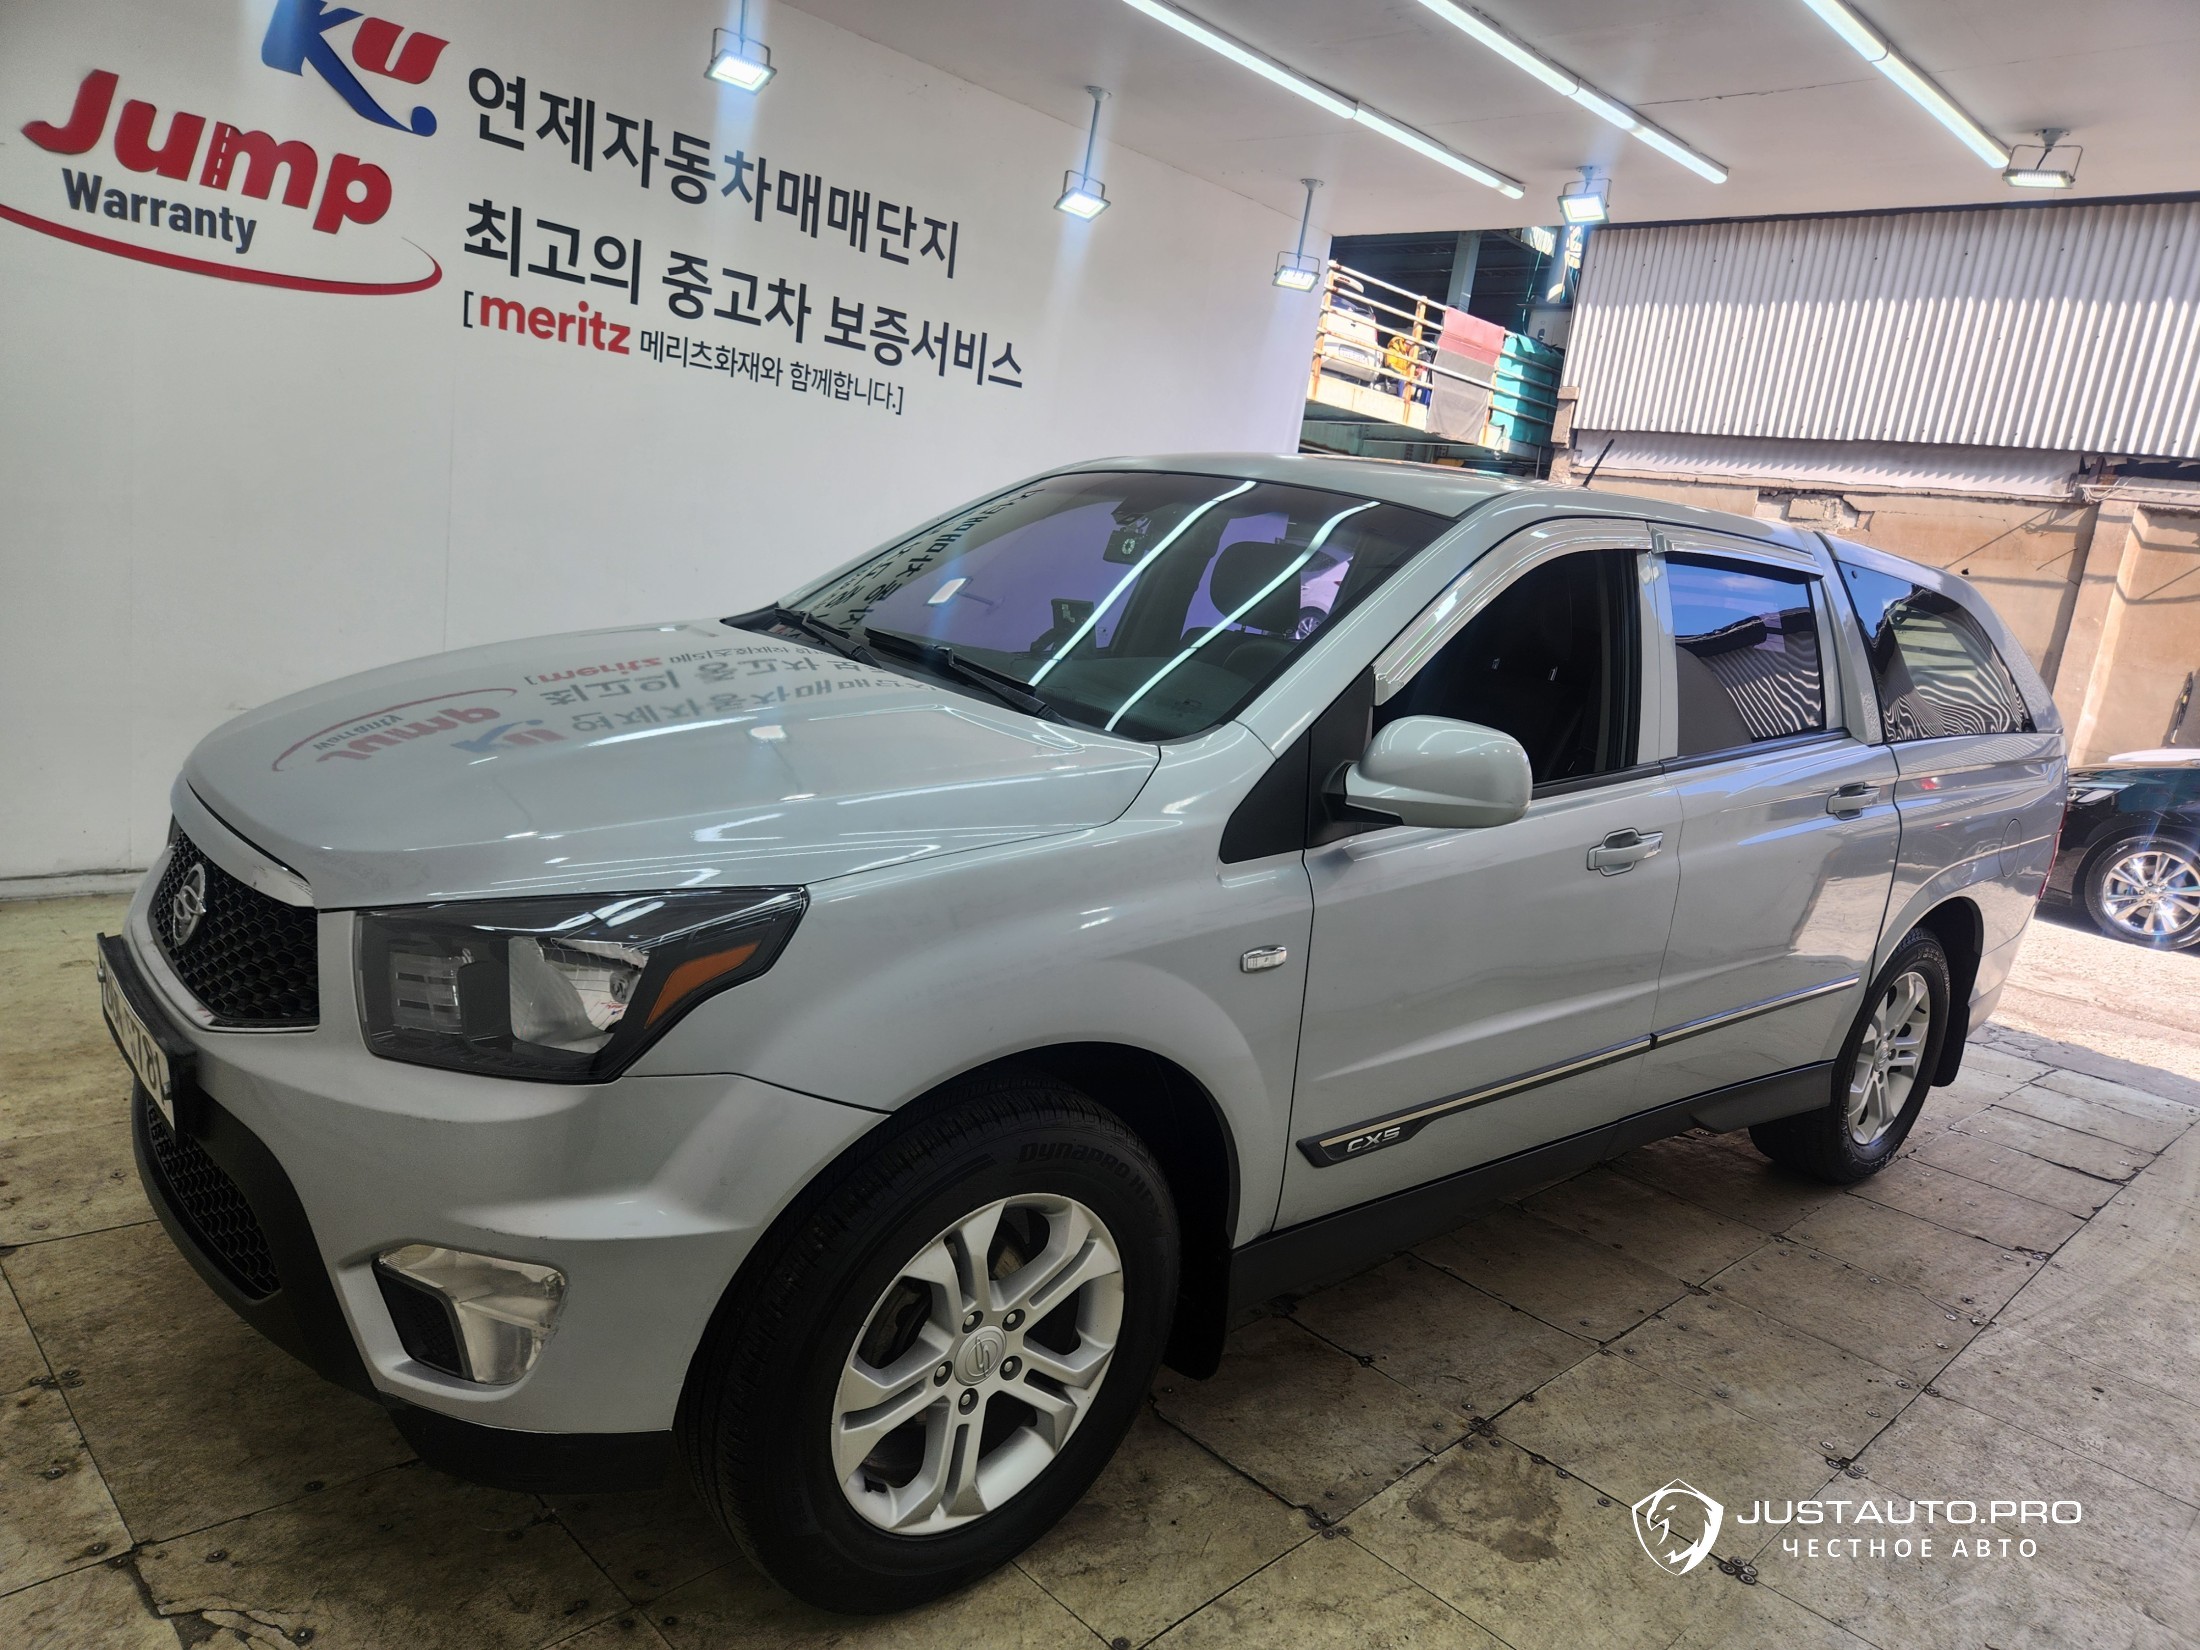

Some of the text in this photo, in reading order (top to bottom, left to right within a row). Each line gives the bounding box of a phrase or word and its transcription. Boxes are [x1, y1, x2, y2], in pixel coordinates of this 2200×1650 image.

[21, 68, 392, 235] Jump
[61, 167, 257, 254] Warranty
[467, 66, 960, 279] 연제자동차매매단지
[463, 199, 1023, 388] 최고의 중고차 보증서비스
[640, 329, 784, 388] 메리츠화재와
[789, 361, 904, 416] 함께합니다.]
[1346, 1126, 1401, 1153] CX5
